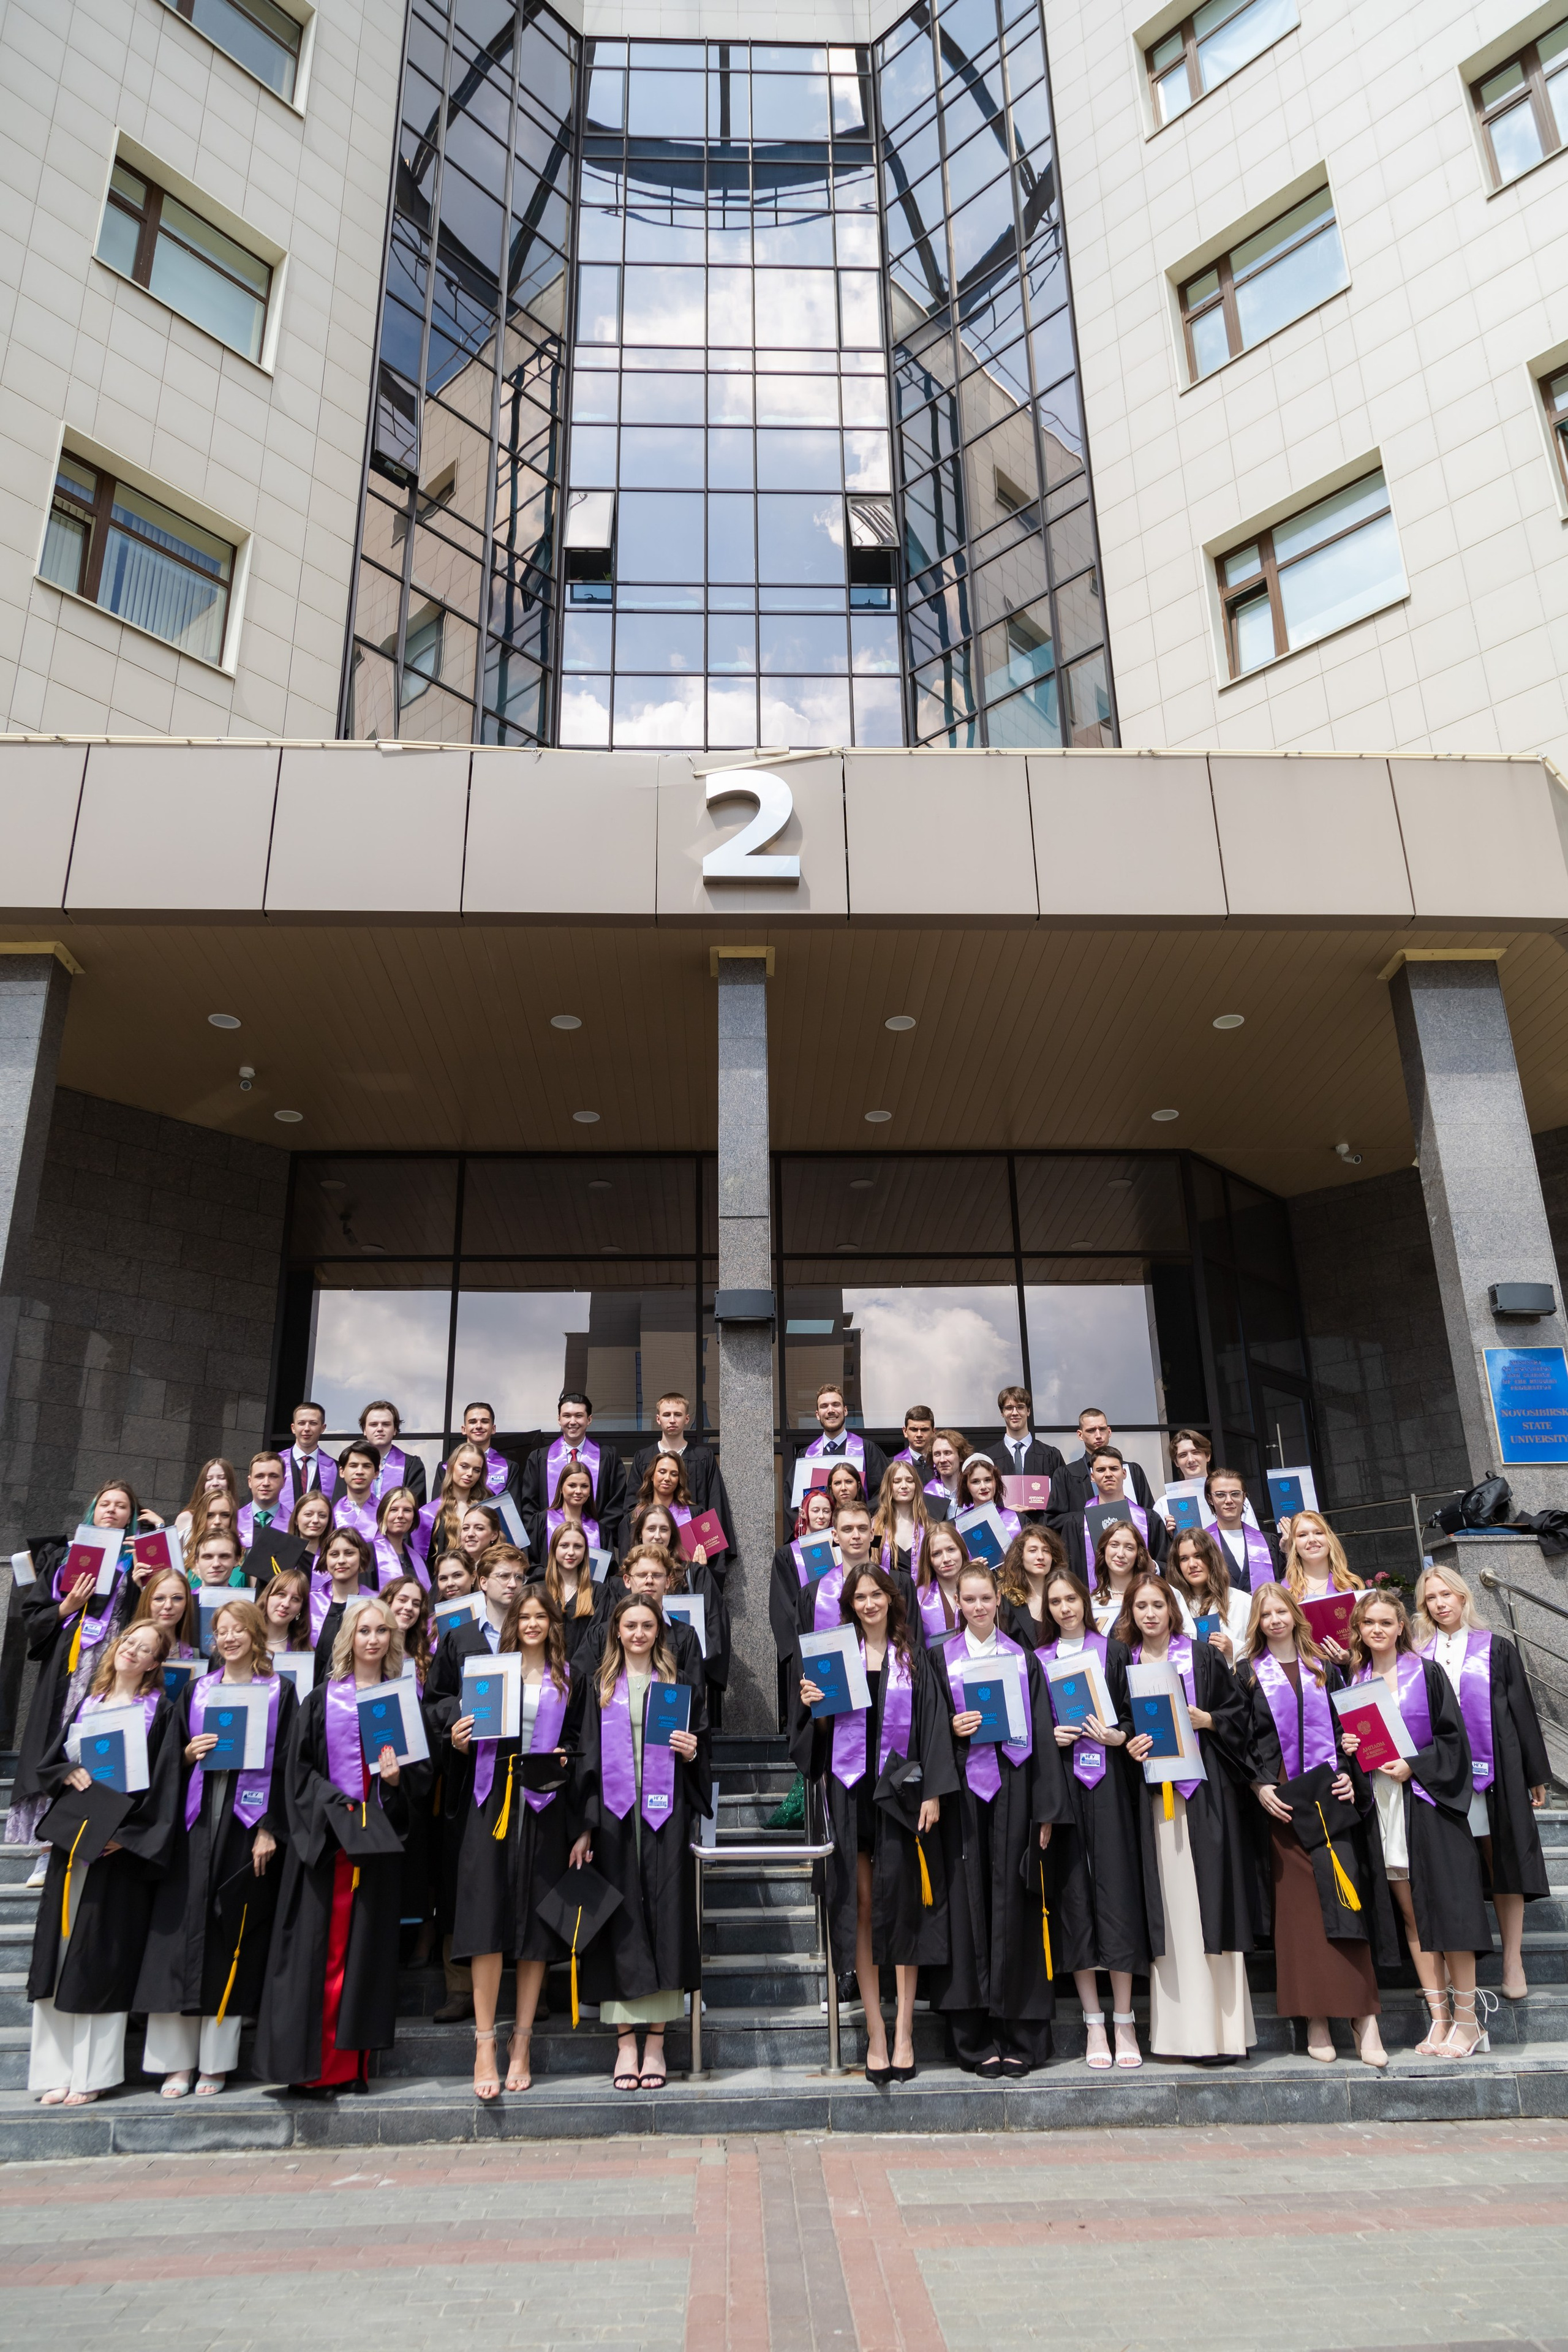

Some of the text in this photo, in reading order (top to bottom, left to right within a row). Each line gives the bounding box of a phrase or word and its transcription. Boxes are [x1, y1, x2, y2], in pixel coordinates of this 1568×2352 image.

[703, 769, 800, 882] 2
[1501, 1408, 1568, 1417] NOVOSIBIRSK
[1510, 1434, 1568, 1444] UNIVERSITY
[704, 1535, 719, 1546] ДИПЛОМ
[1336, 1626, 1351, 1635] ДИПЛ
[1362, 1741, 1385, 1754] ДИПЛОМ
